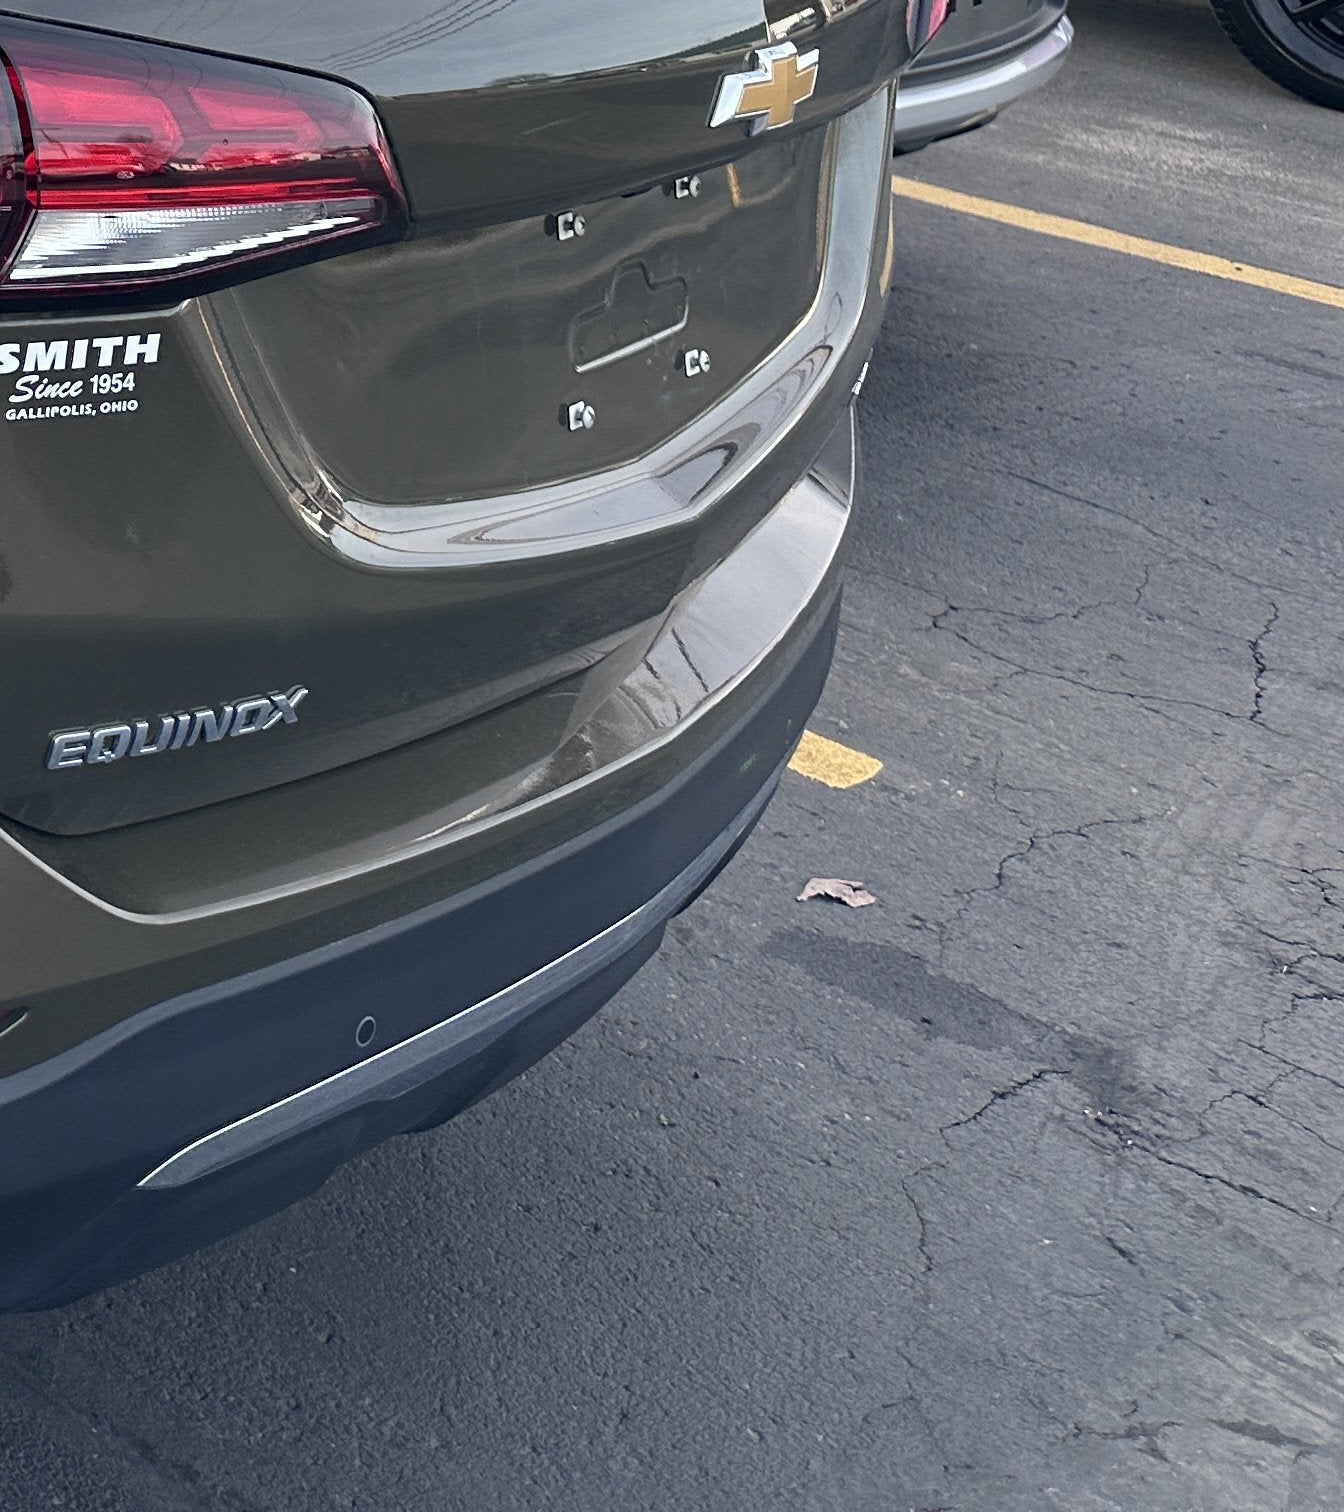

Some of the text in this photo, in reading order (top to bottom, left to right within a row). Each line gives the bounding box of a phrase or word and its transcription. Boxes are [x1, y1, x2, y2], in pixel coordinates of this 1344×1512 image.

[8, 372, 136, 403] Since 1954
[5, 399, 139, 421] GALLIPOLIS, OHIO
[47, 685, 309, 770] EQUINOX
